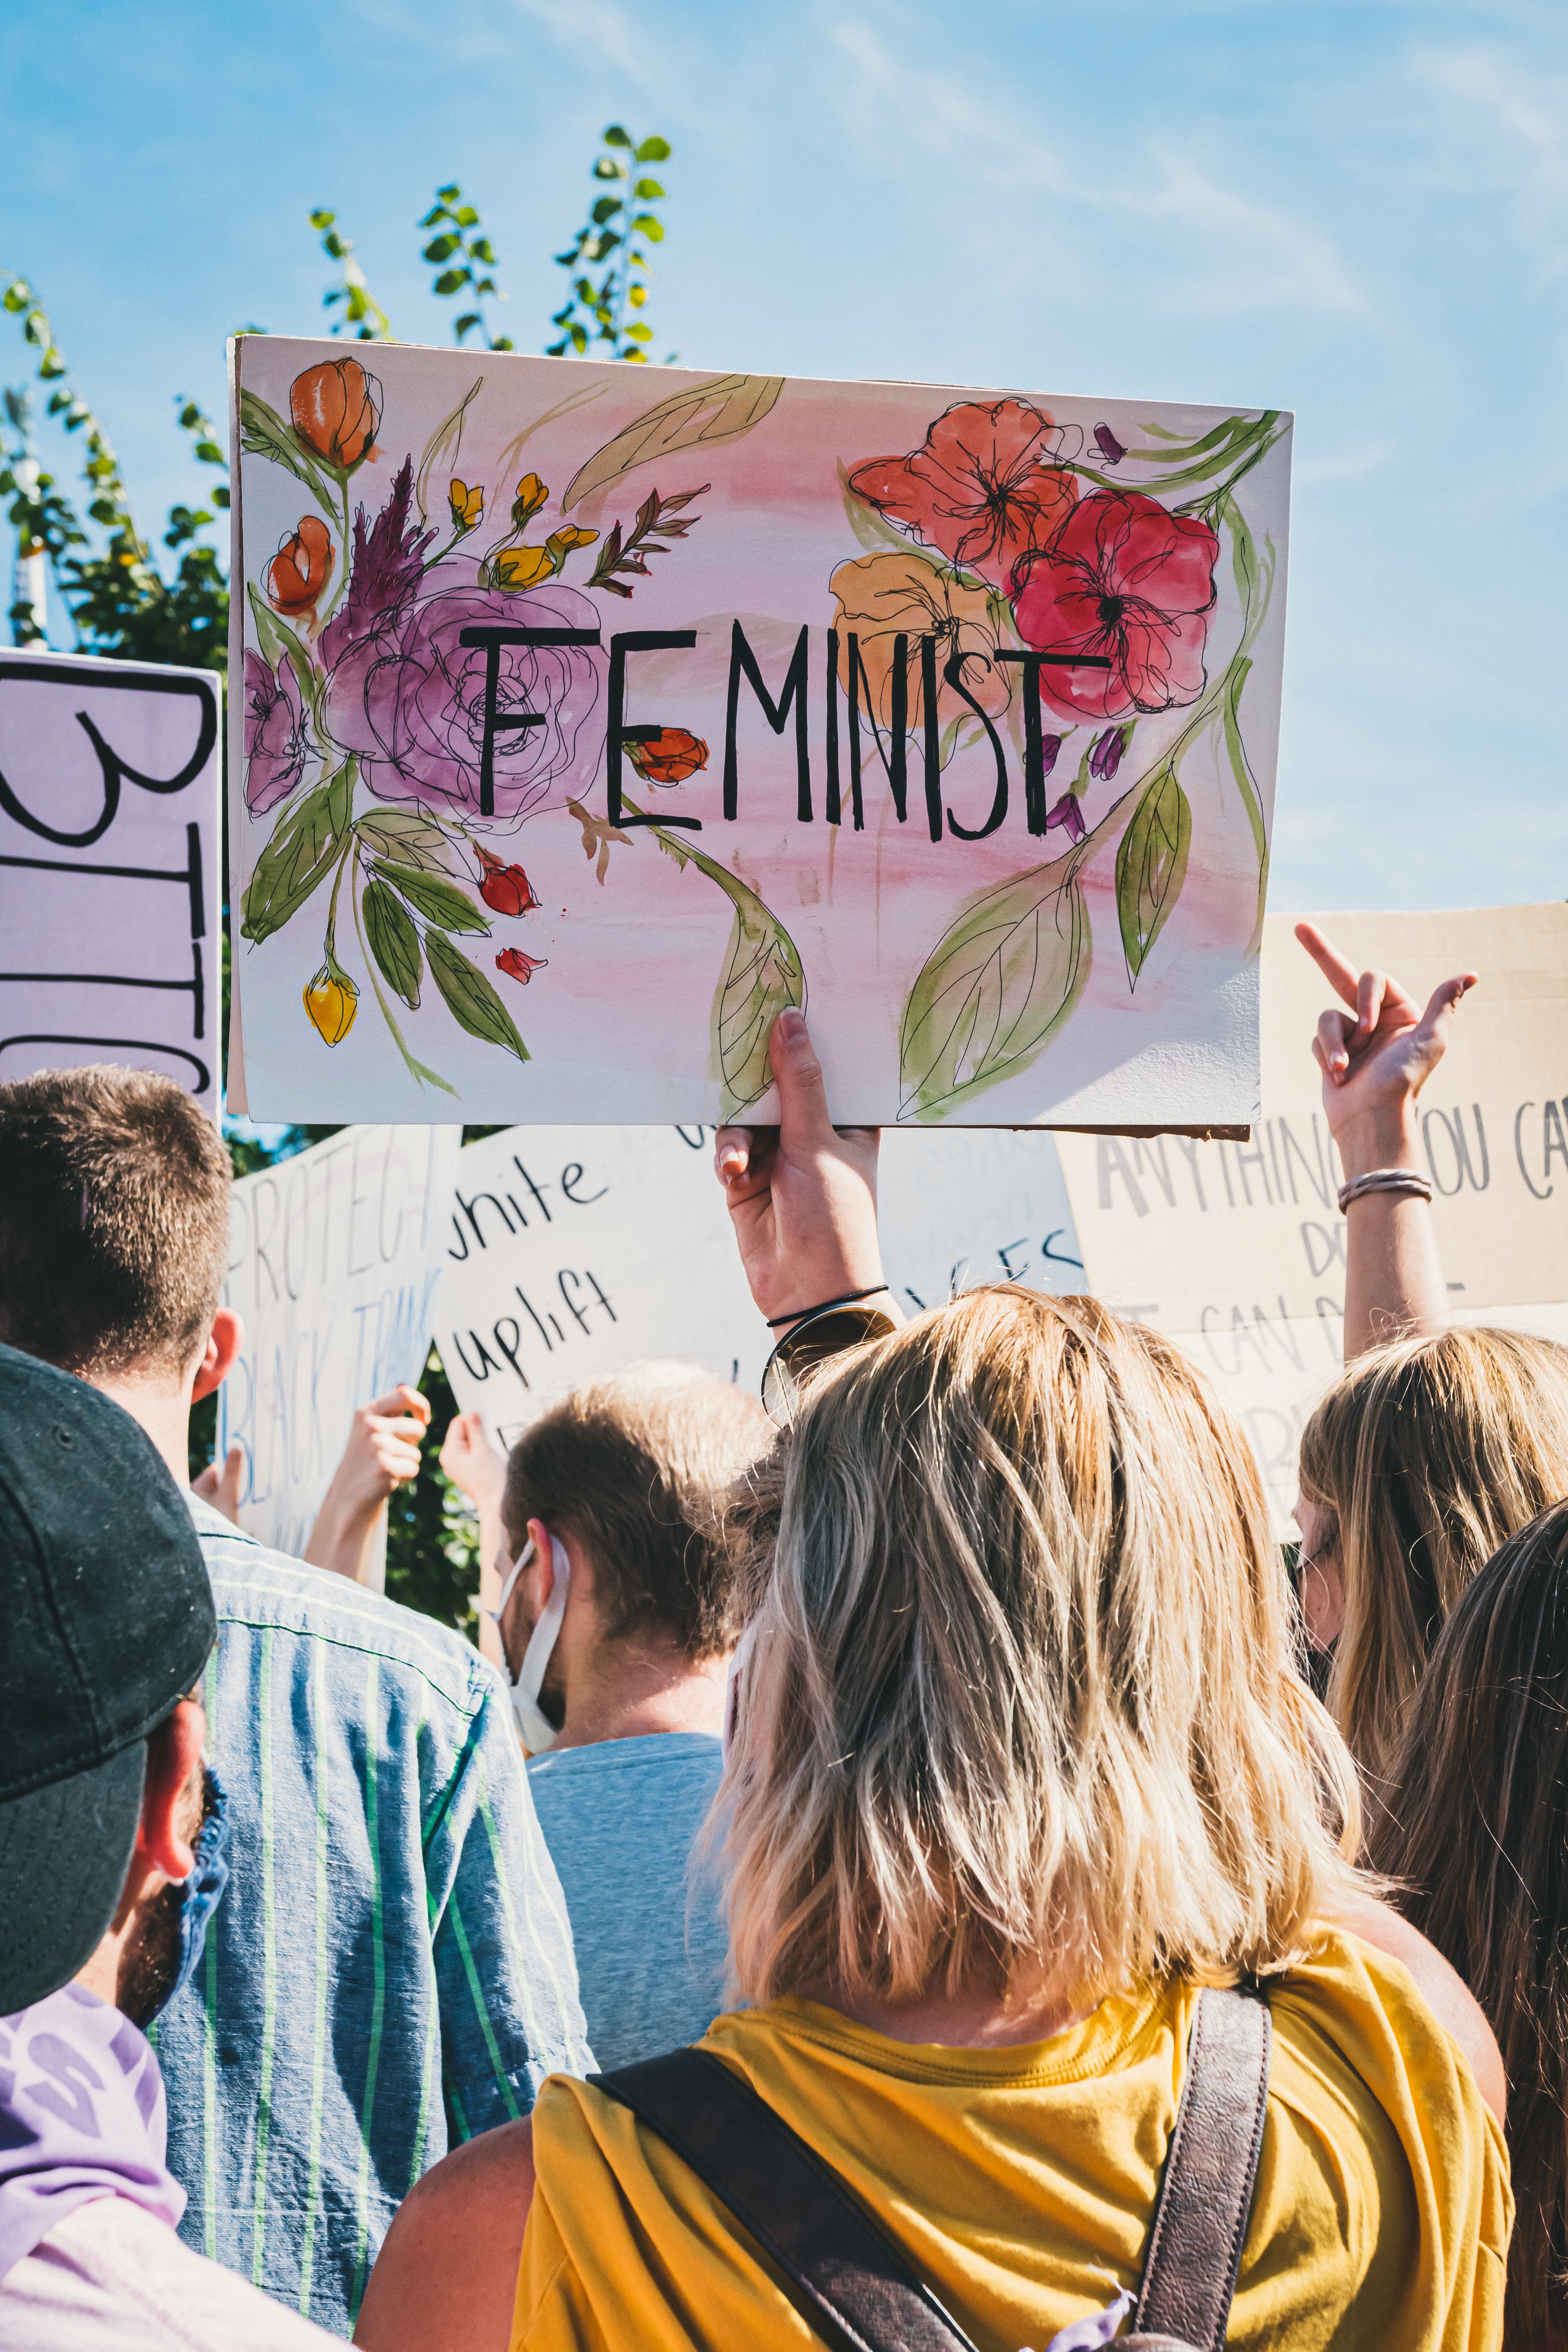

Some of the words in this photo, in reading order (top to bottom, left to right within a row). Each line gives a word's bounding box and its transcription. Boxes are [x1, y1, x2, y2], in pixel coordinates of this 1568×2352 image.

[459, 619, 1112, 843] FEMINIST
[1096, 1110, 1345, 1218] ANYTHIN
[1414, 1102, 1490, 1197] OU
[1514, 1096, 1568, 1201] CA
[453, 1270, 618, 1391] uplift
